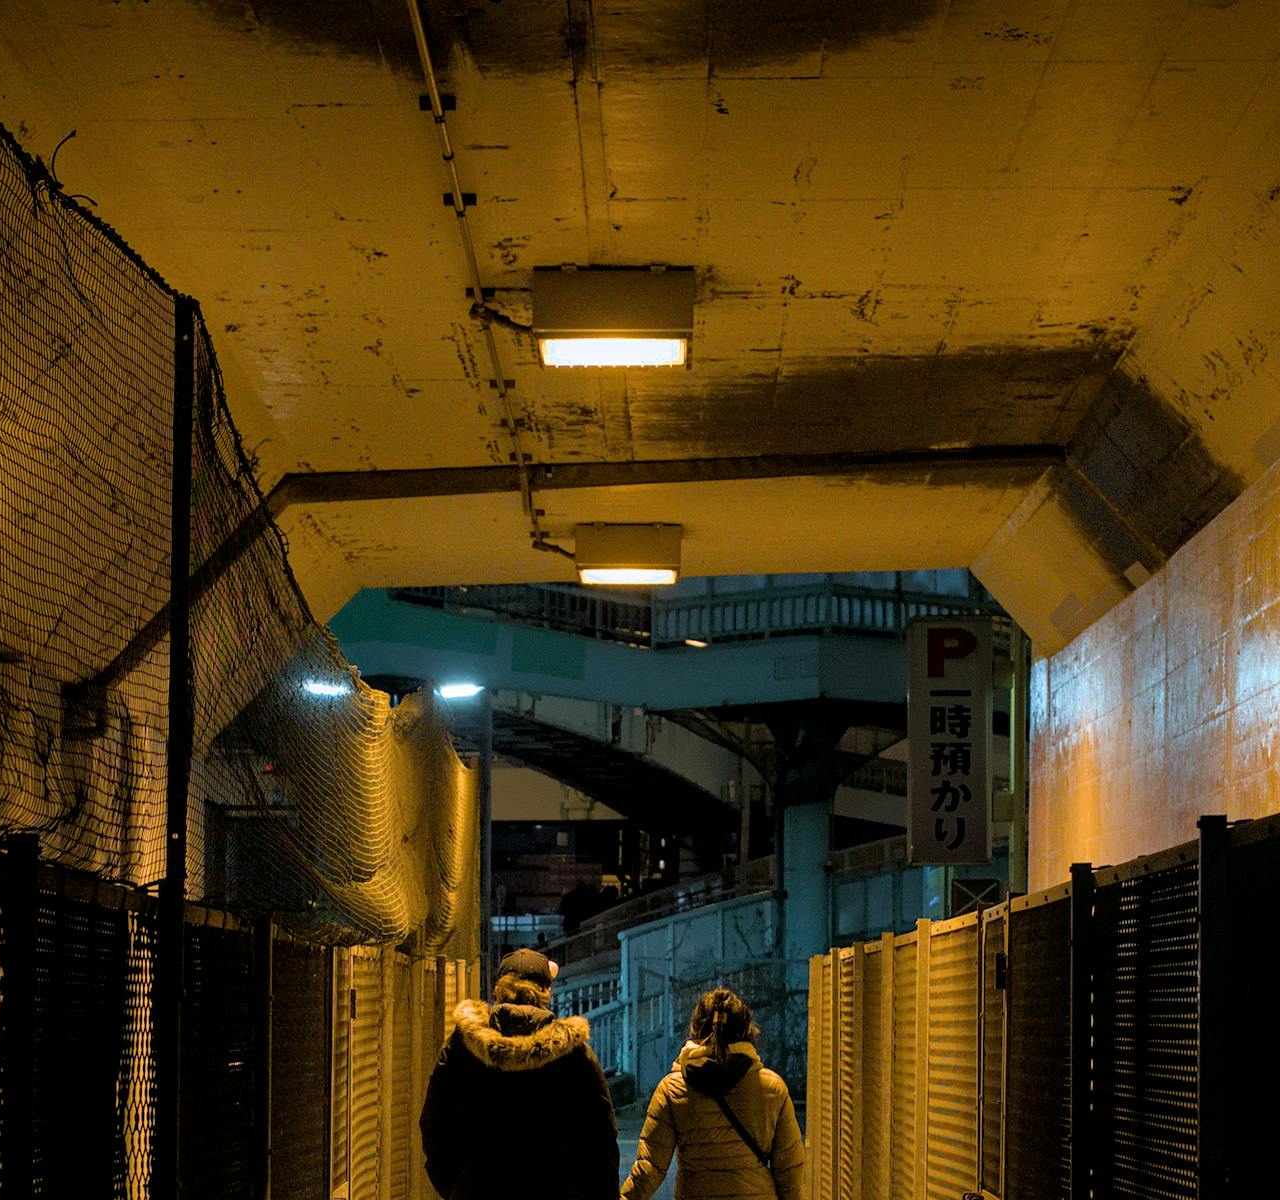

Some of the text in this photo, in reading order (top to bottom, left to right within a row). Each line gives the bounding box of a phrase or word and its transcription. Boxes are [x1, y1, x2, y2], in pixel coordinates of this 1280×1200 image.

[927, 628, 976, 677] P
[929, 690, 972, 850] 一時預かり
